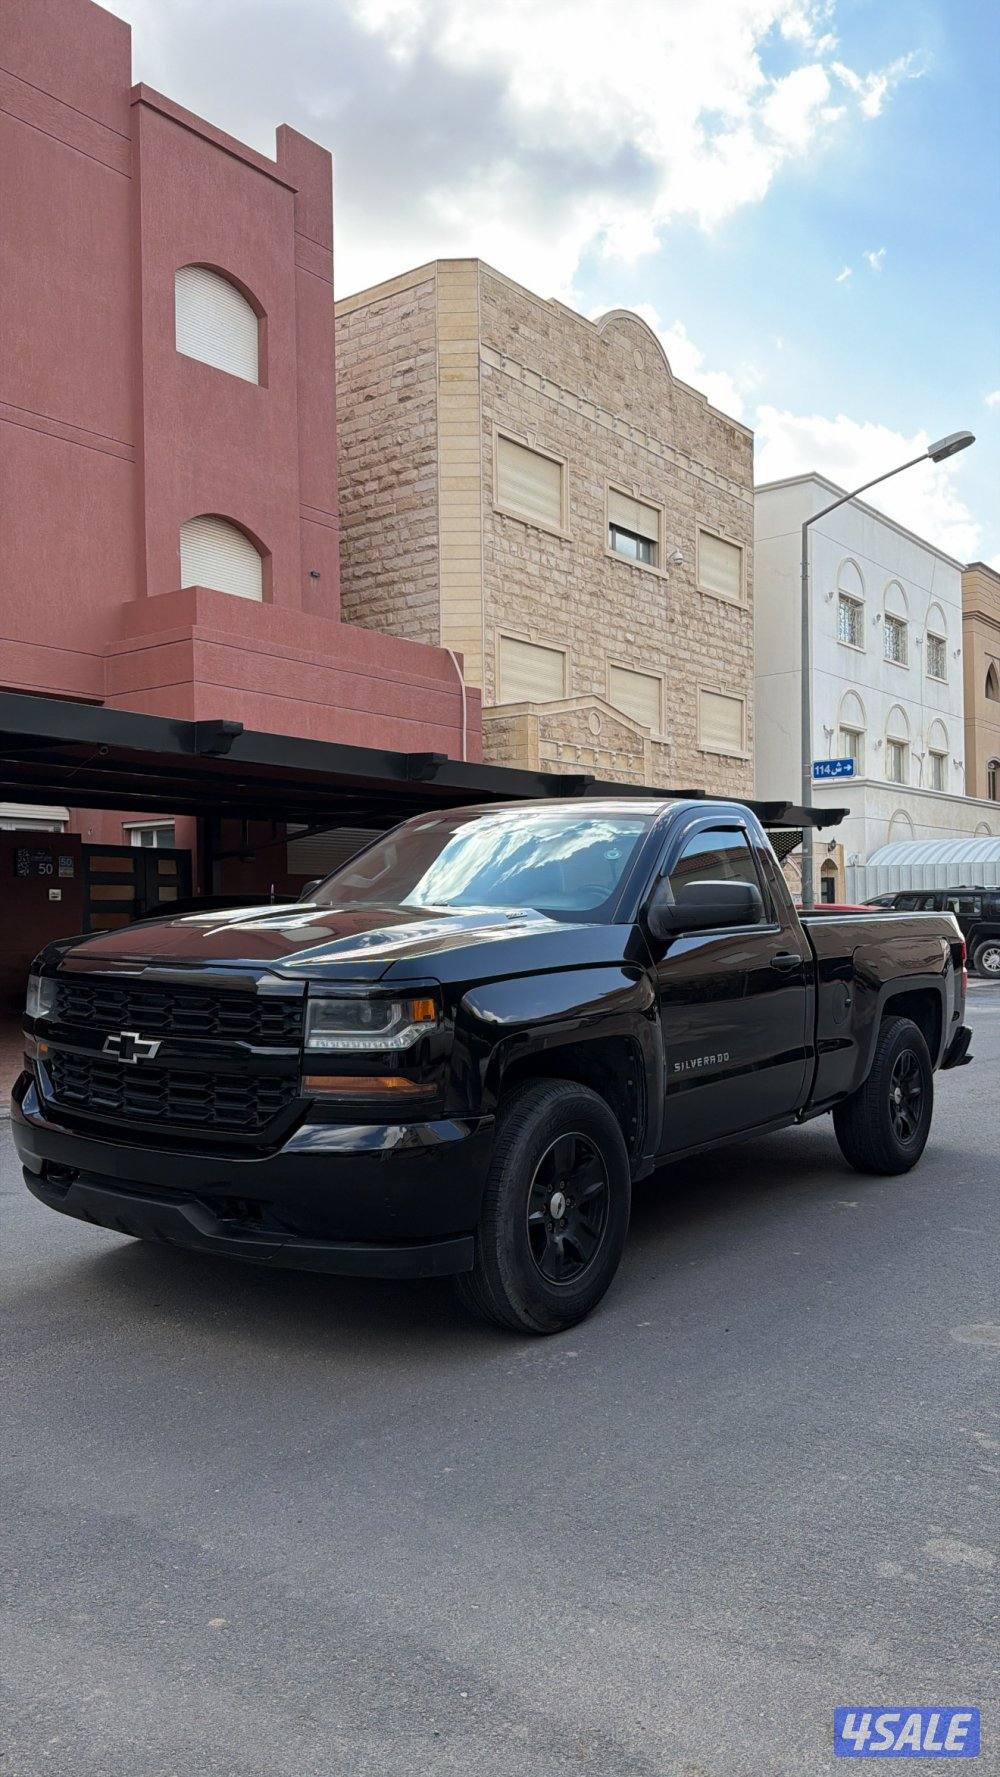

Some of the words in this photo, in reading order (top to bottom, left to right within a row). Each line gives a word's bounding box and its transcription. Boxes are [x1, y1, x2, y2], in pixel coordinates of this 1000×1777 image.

[814, 765, 830, 775] 114
[60, 857, 72, 866] 50
[38, 863, 53, 875] 50
[674, 1052, 730, 1072] SILVERADO
